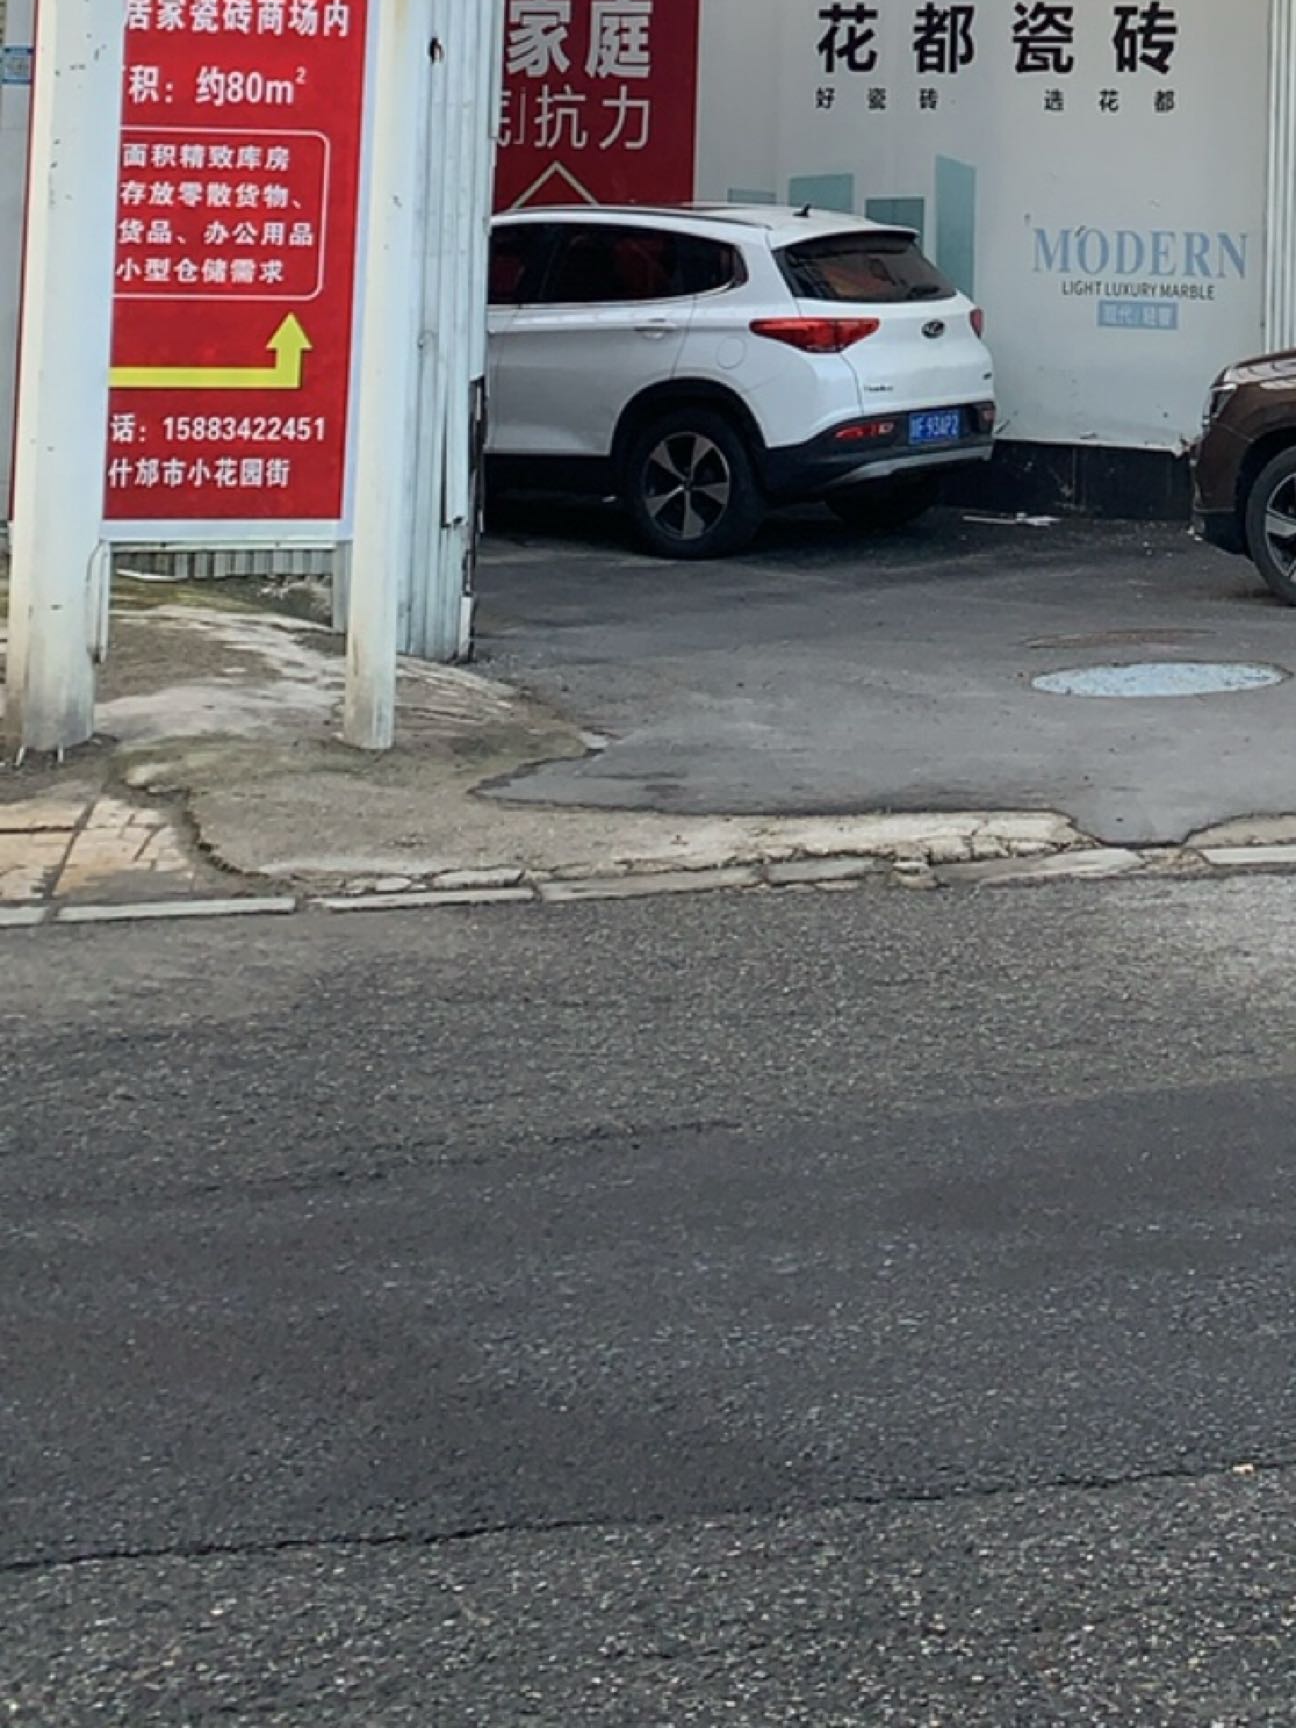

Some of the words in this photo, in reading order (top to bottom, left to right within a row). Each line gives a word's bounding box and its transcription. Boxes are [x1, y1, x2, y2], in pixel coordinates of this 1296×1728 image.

[816, 1, 1178, 75] 花都瓷砖
[815, 87, 938, 111] 好瓷砖
[1044, 88, 1175, 112] 选花都
[122, 143, 290, 172] 面积精致库房
[118, 217, 313, 246] 货品、办公用品
[1032, 227, 1248, 279] MODERN
[116, 257, 283, 284] 小型仓储需求
[1062, 280, 1101, 296] LIGHT
[1105, 281, 1157, 298] LUXURY
[1160, 283, 1216, 301] MARBLE
[108, 457, 291, 488] 什邡市小花园街
